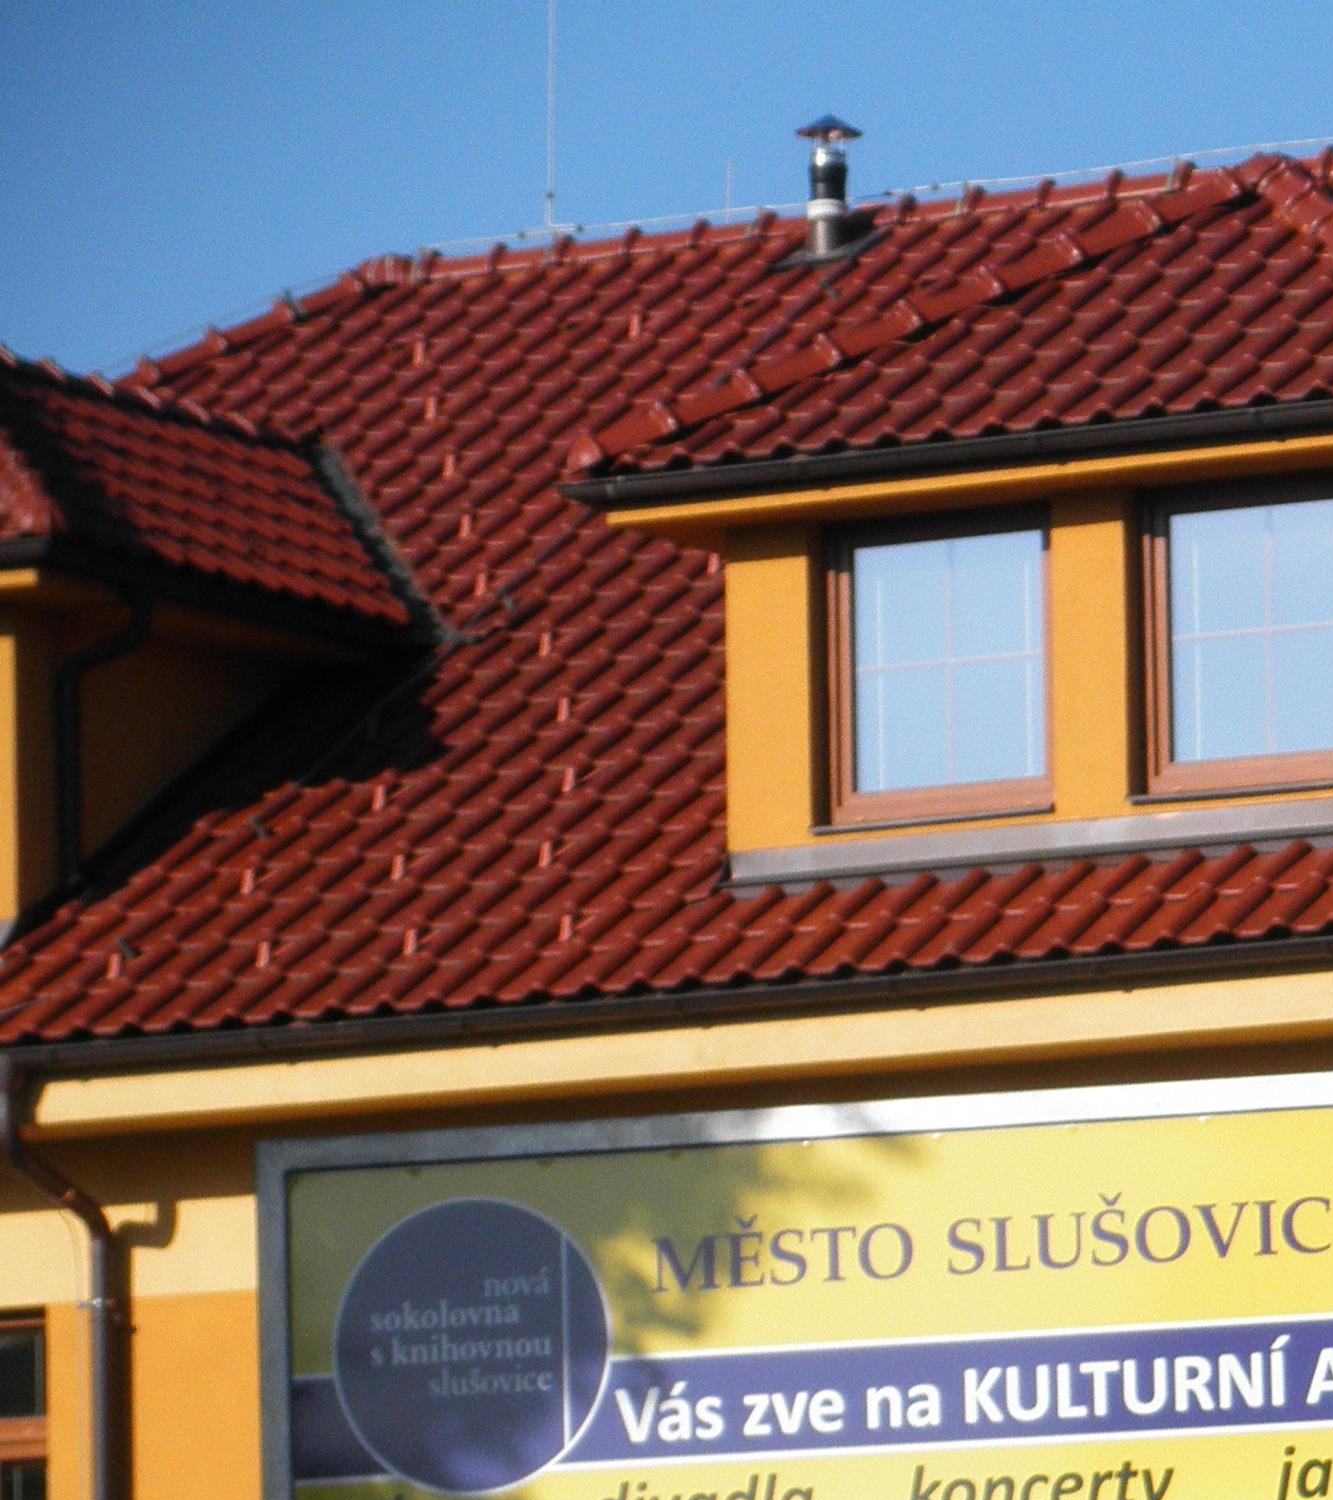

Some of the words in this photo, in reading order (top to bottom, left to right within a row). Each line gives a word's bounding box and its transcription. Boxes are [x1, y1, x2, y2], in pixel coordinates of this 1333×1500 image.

[651, 1214, 914, 1293] MĚSTO
[483, 1267, 551, 1298] nová
[370, 1299, 520, 1332] sokolovna
[370, 1347, 384, 1367] s
[391, 1333, 552, 1364] knihovnou
[428, 1365, 553, 1397] slušovice
[614, 1381, 723, 1444] Vás
[743, 1388, 843, 1436] zve
[866, 1382, 940, 1430] na
[963, 1334, 1291, 1423] KULTURNÍ
